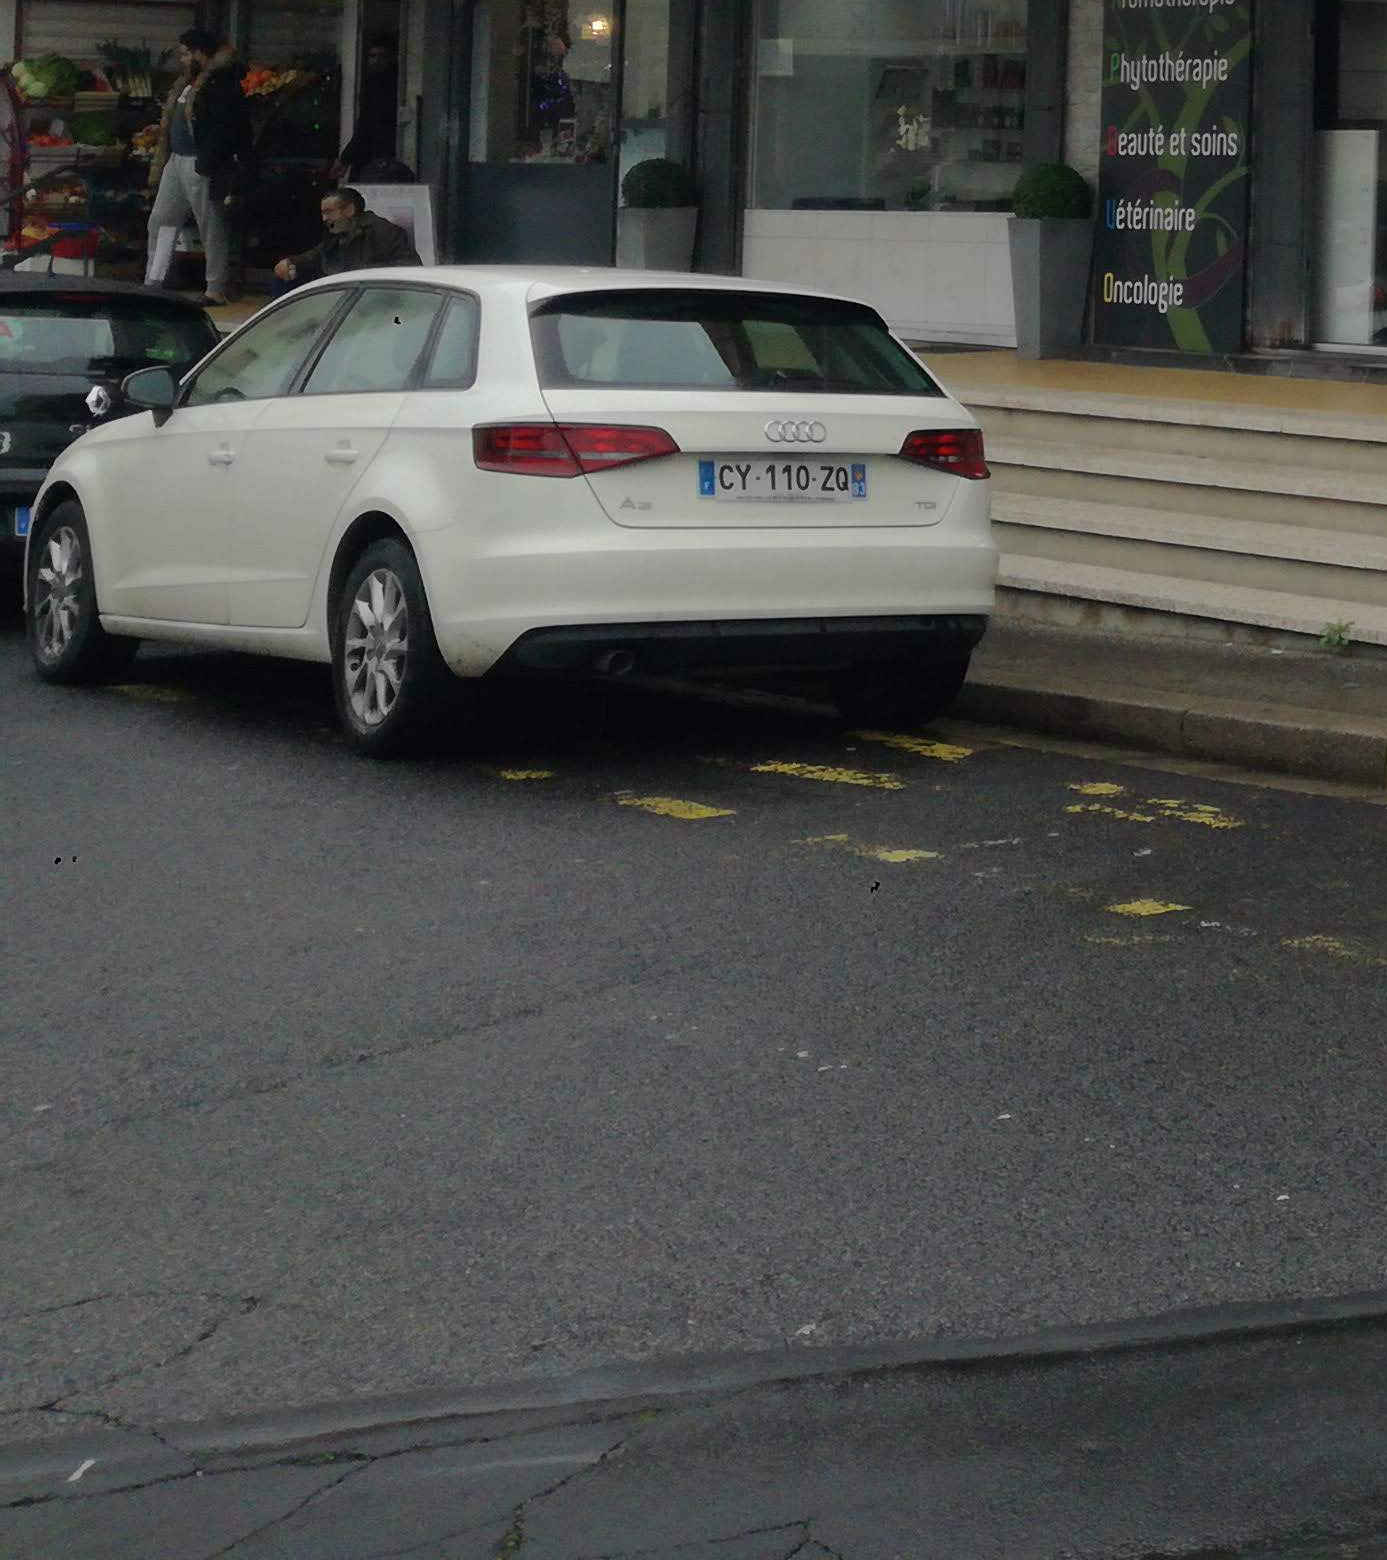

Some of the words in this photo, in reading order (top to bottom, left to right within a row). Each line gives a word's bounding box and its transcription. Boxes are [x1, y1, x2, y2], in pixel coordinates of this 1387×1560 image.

[1110, 50, 1228, 91] Phytothérapie
[1106, 125, 1165, 157] Beauté
[1169, 127, 1187, 156] et
[1190, 125, 1238, 156] soins
[1106, 198, 1196, 231] Vétérinaire
[1103, 272, 1184, 314] Oncologie
